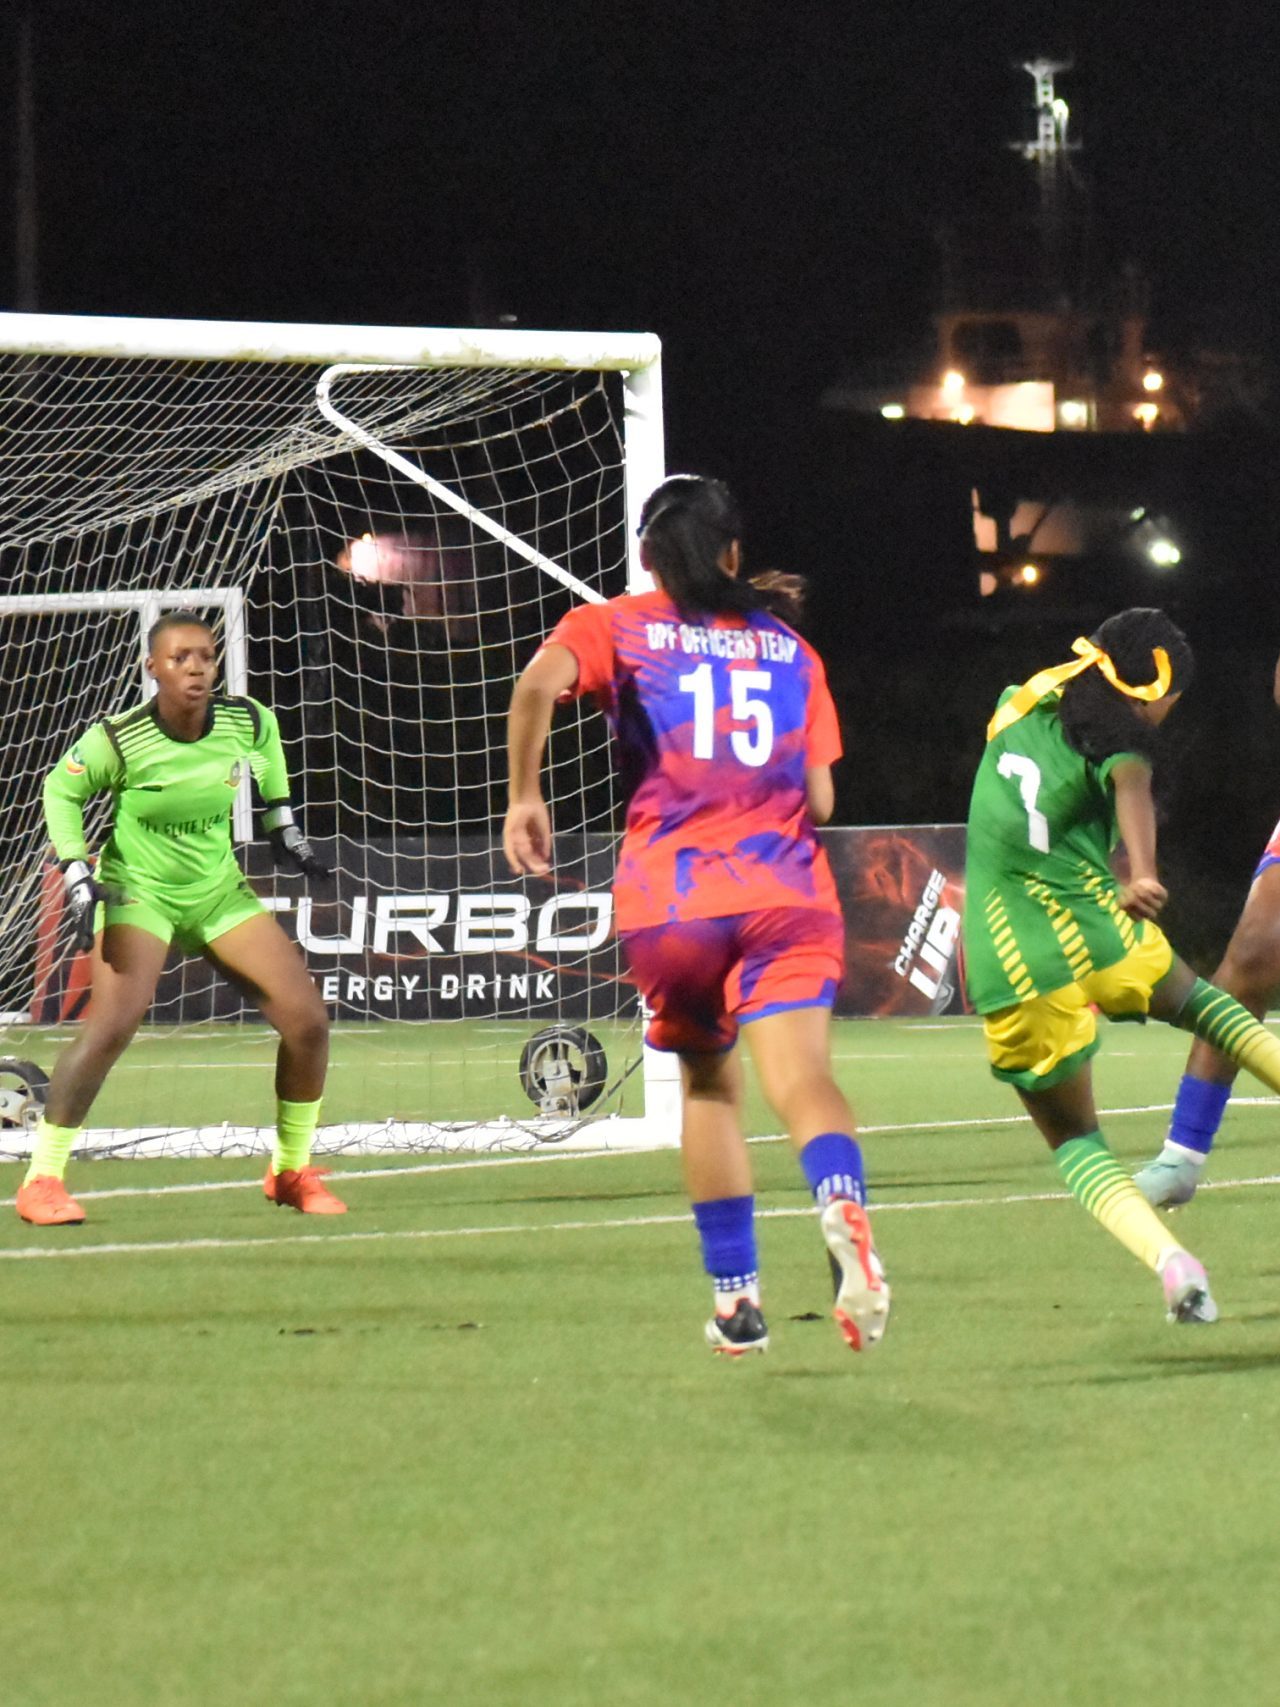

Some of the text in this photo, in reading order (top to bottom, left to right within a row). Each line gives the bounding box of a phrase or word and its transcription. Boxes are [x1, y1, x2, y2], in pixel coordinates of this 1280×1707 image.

[679, 624, 757, 660] OFFICERS
[678, 663, 773, 767] 15
[996, 752, 1050, 854] 7
[894, 868, 947, 977] CHARGE
[312, 973, 556, 1001] ERGY DRINK
